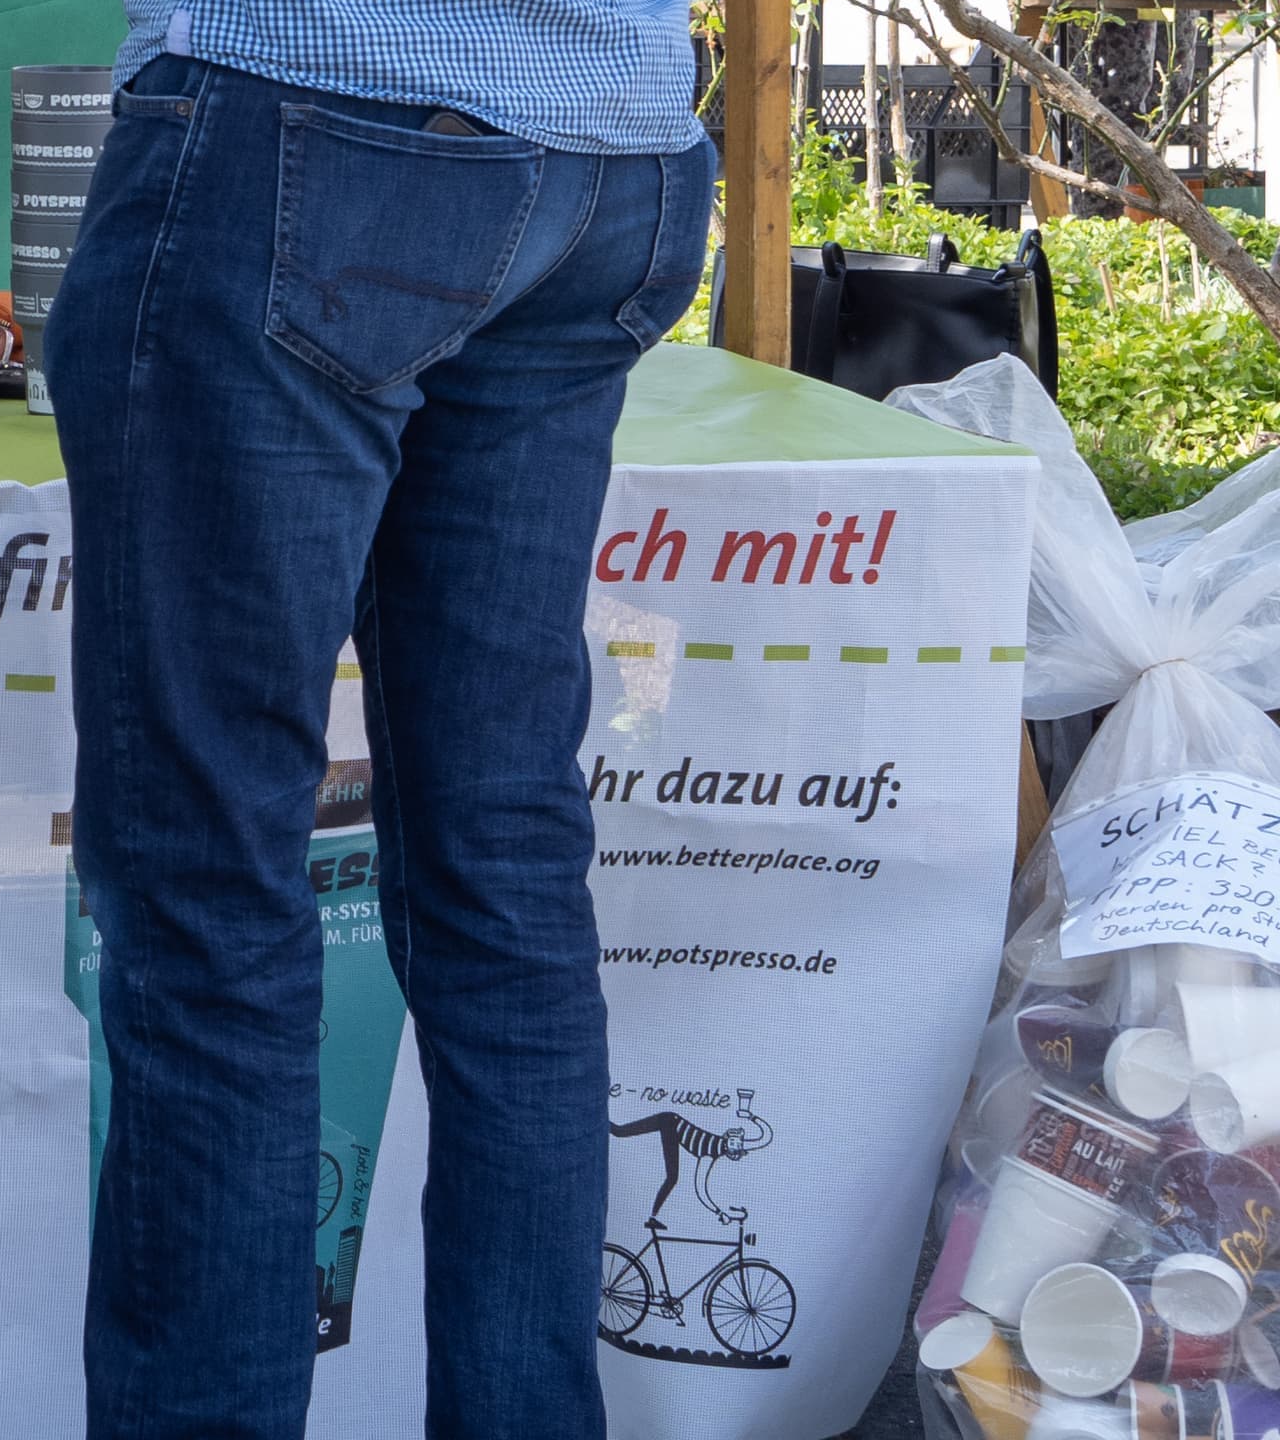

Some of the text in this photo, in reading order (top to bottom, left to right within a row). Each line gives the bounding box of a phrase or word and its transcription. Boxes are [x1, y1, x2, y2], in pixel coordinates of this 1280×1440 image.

[711, 510, 897, 585] mit!
[656, 757, 784, 806] dazu
[798, 762, 902, 822] auf:
[598, 845, 881, 880] www.betterplace.org
[1098, 917, 1271, 948] Deutschland
[641, 1085, 670, 1103] no
[671, 1086, 731, 1109] waste
[1071, 1138, 1095, 1160] AU
